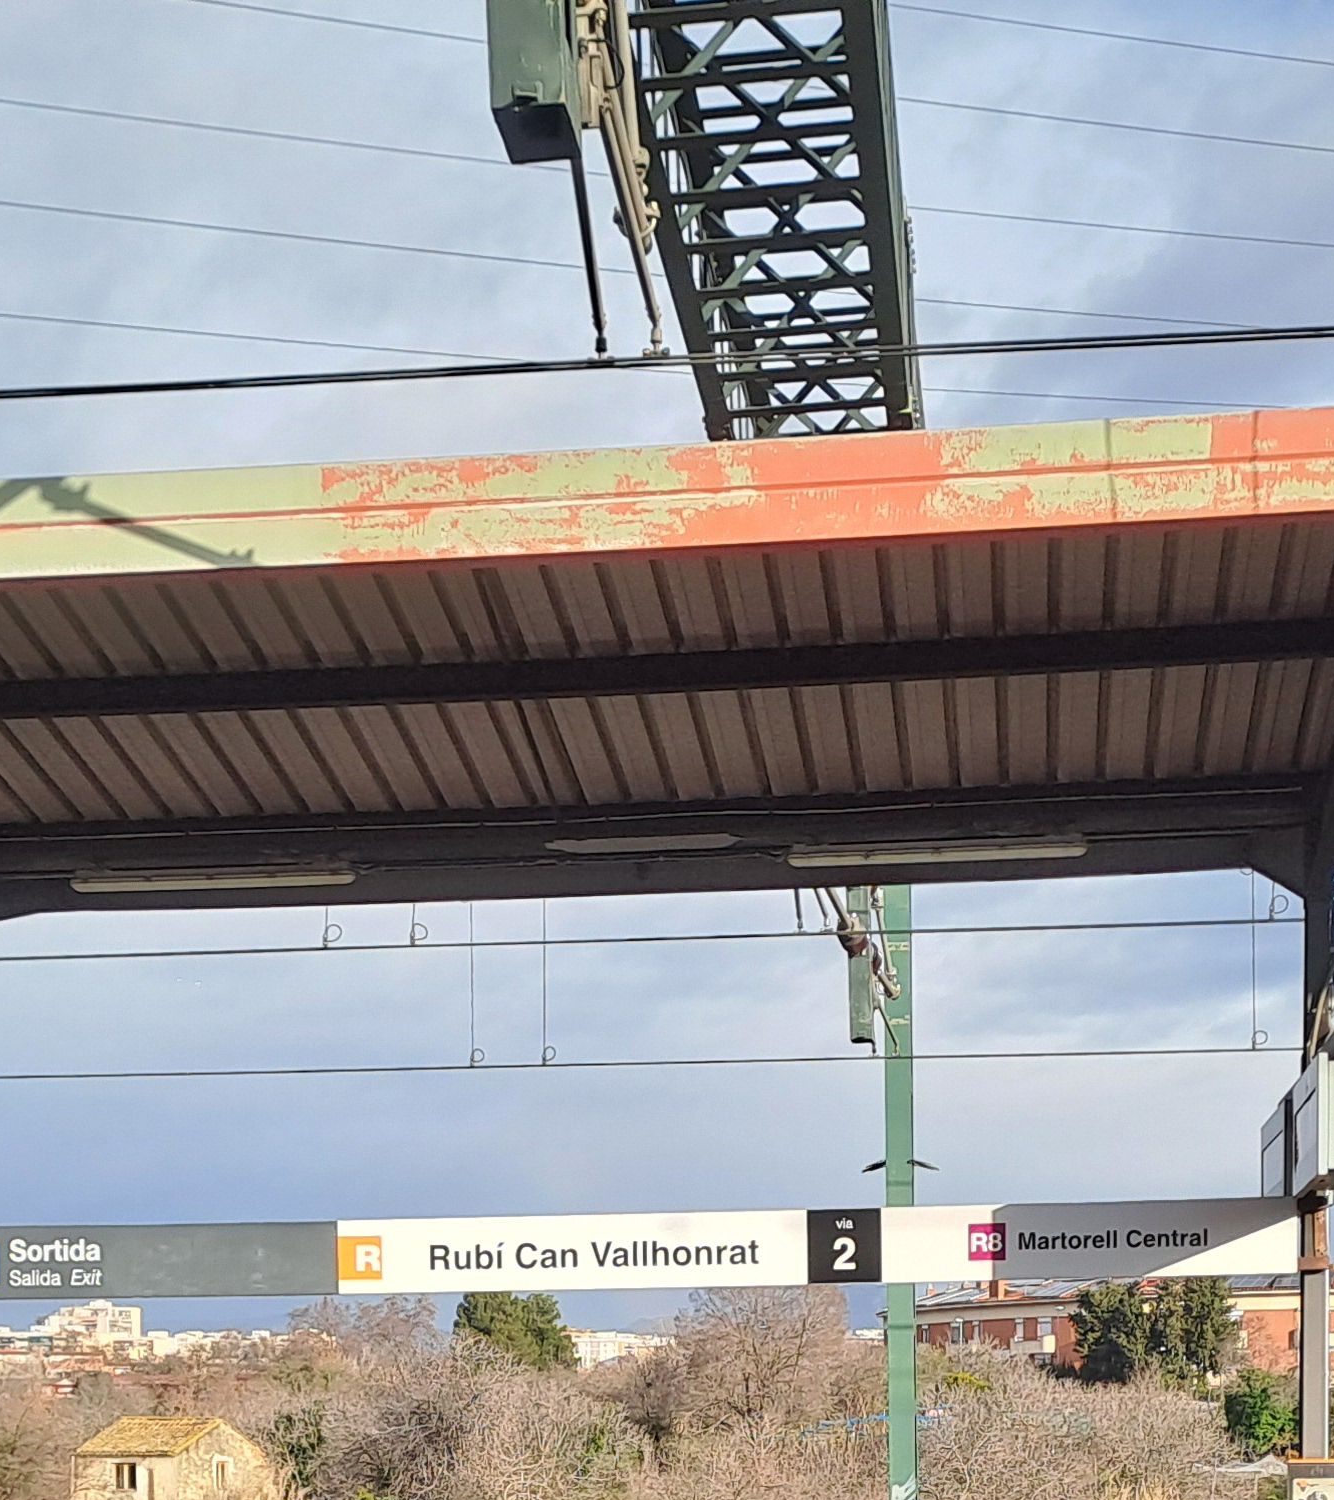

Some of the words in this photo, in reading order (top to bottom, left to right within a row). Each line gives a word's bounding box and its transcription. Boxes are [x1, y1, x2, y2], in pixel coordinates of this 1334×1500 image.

[835, 1217, 854, 1229] via
[8, 1238, 102, 1262] Sortida
[970, 1232, 1003, 1253] R8
[1018, 1229, 1118, 1251] Martorell
[1125, 1227, 1209, 1249] Central
[355, 1243, 382, 1273] R
[429, 1241, 504, 1271] Rubí
[515, 1242, 579, 1269] Can
[591, 1239, 760, 1267] Vallhonrat
[832, 1236, 857, 1270] 2
[8, 1268, 63, 1287] Salida
[69, 1268, 103, 1287] Exit
